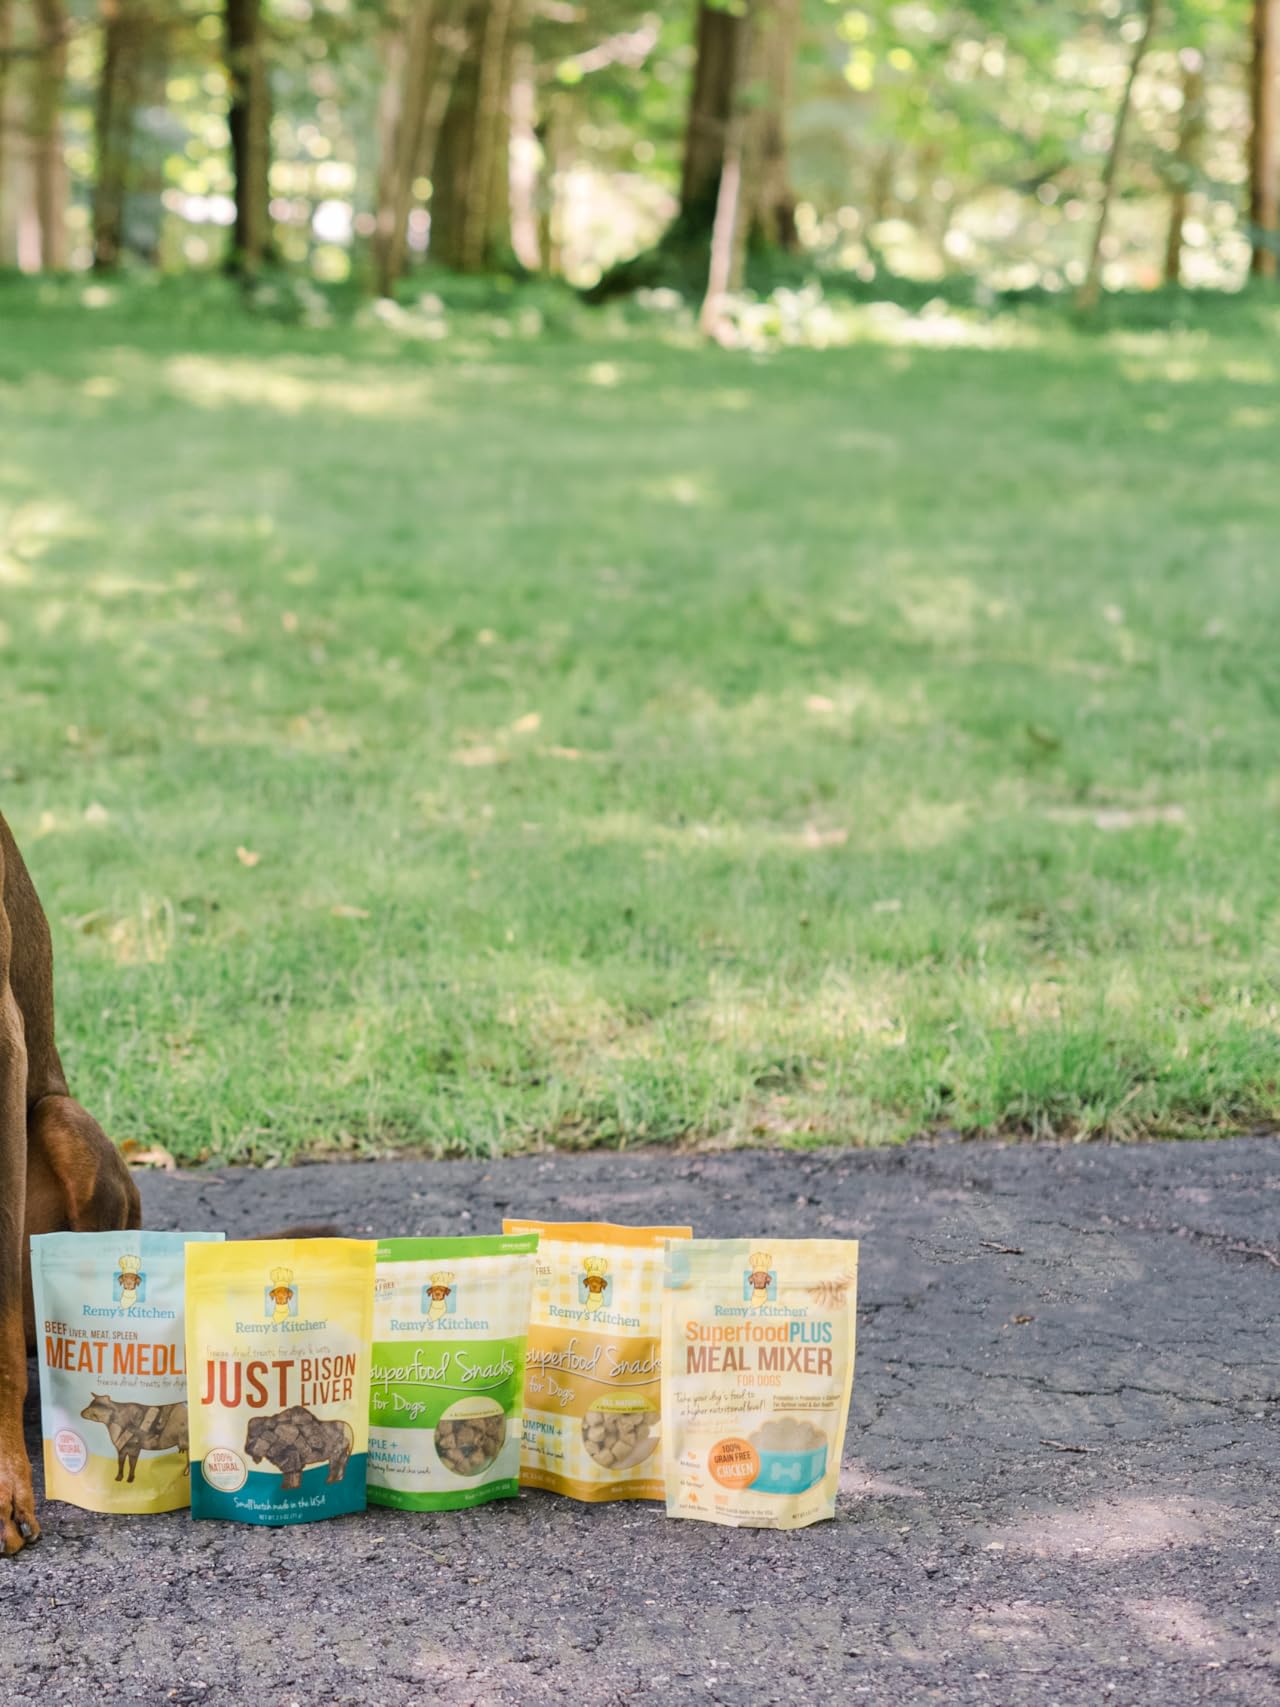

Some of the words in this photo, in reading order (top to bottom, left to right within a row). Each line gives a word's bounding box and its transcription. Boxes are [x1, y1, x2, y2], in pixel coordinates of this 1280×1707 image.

[83, 1305, 124, 1319] Remy's
[127, 1306, 175, 1319] Kitchen
[549, 1305, 590, 1321] Remy's
[593, 1311, 640, 1328] Kitchen
[714, 1305, 756, 1318] Remy's
[759, 1305, 807, 1317] Kitchen
[45, 1320, 67, 1336] BEEF
[112, 1330, 138, 1341] SPLEEN
[236, 1321, 277, 1334] Remy's
[281, 1319, 326, 1332] Kitchen
[390, 1319, 434, 1332] Remy's
[437, 1318, 489, 1331] Kitchen
[45, 1336, 109, 1374] MEAT
[113, 1343, 187, 1376] MEDL
[455, 1348, 514, 1382] Snacks
[686, 1345, 751, 1375] MEAL
[758, 1346, 832, 1376] MIXER
[201, 1360, 294, 1408] JUST
[301, 1353, 356, 1382] BISON
[737, 1375, 754, 1386] FOR
[757, 1375, 782, 1387] DOGS
[301, 1378, 352, 1407] LIVER
[529, 1376, 544, 1392] for
[547, 1376, 575, 1407] Dogs
[372, 1392, 389, 1410] for
[393, 1393, 426, 1420] Dogs
[209, 1462, 240, 1472] NATURAL
[714, 1453, 734, 1463] GRAIN
[734, 1451, 751, 1460] FREE
[297, 1497, 309, 1508] the
